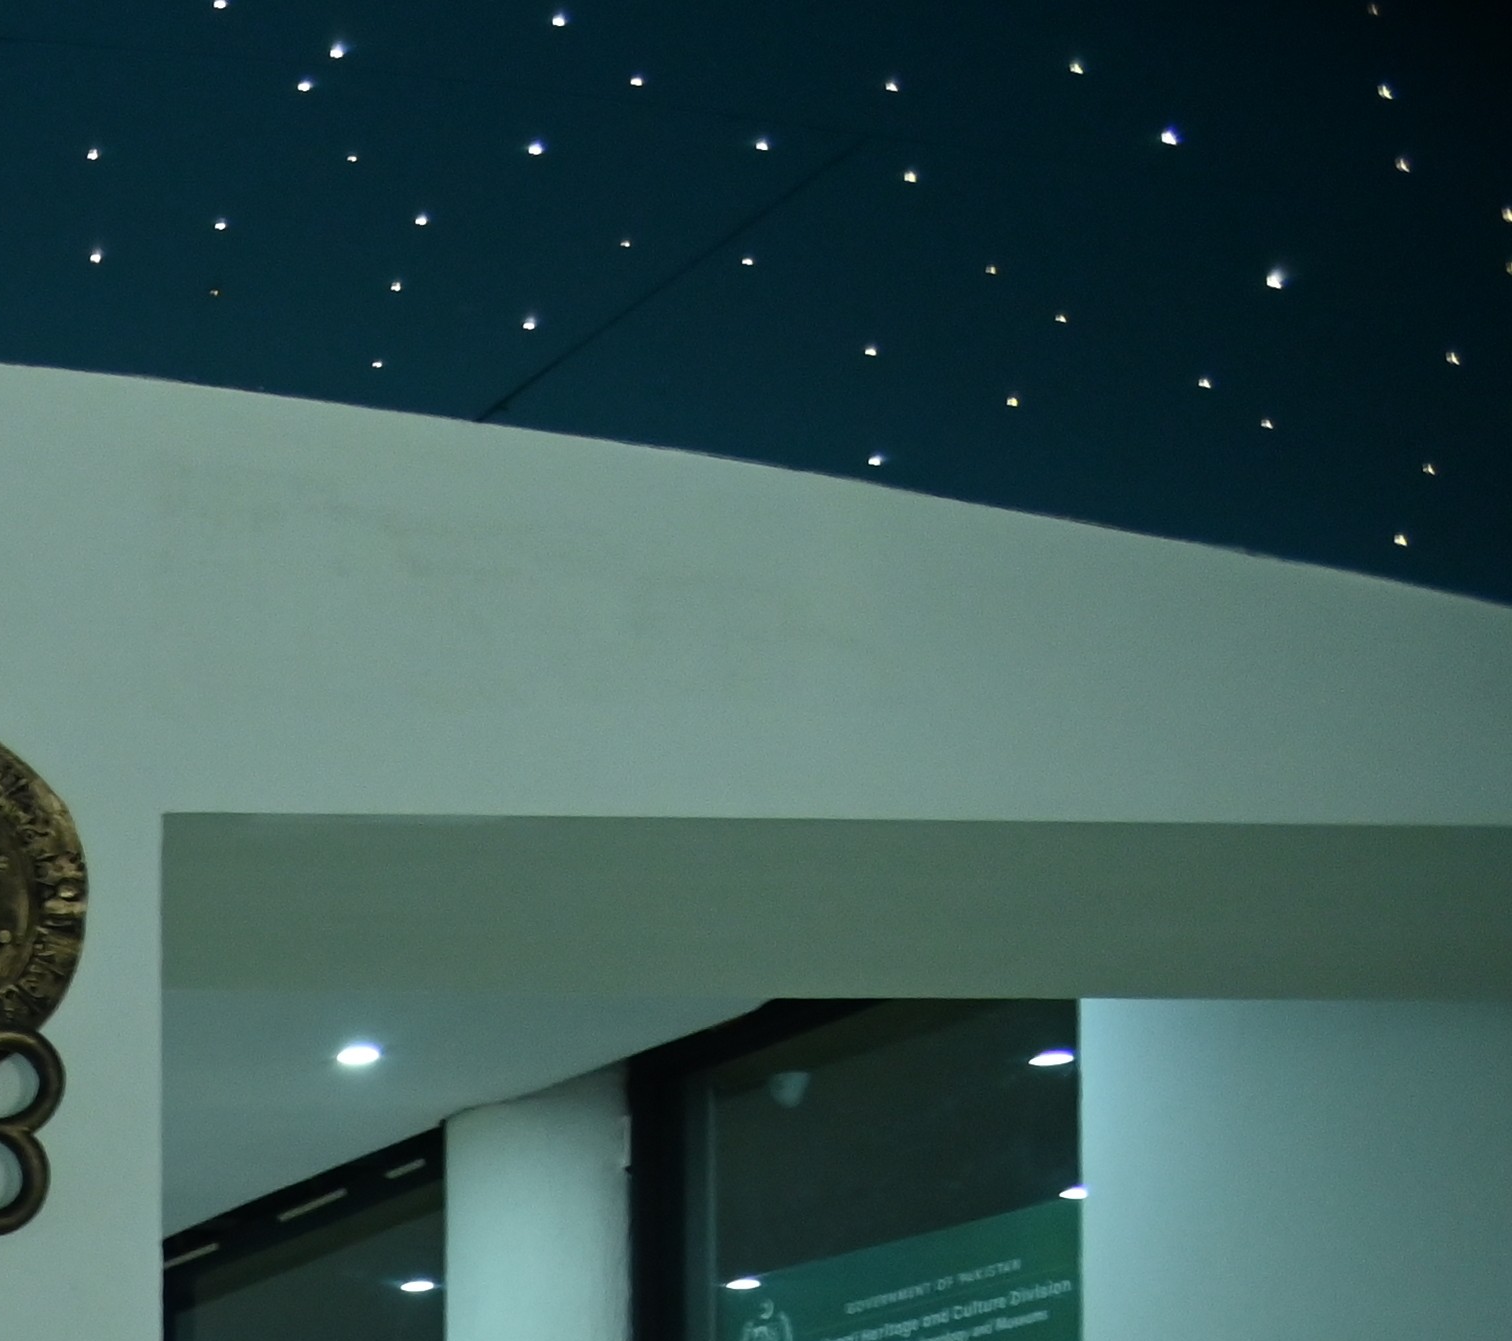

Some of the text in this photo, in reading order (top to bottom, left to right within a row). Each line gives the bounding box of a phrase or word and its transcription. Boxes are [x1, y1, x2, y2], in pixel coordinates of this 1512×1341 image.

[923, 1310, 950, 1327] and
[953, 1297, 1007, 1320] Culture
[1010, 1280, 1071, 1306] Division
